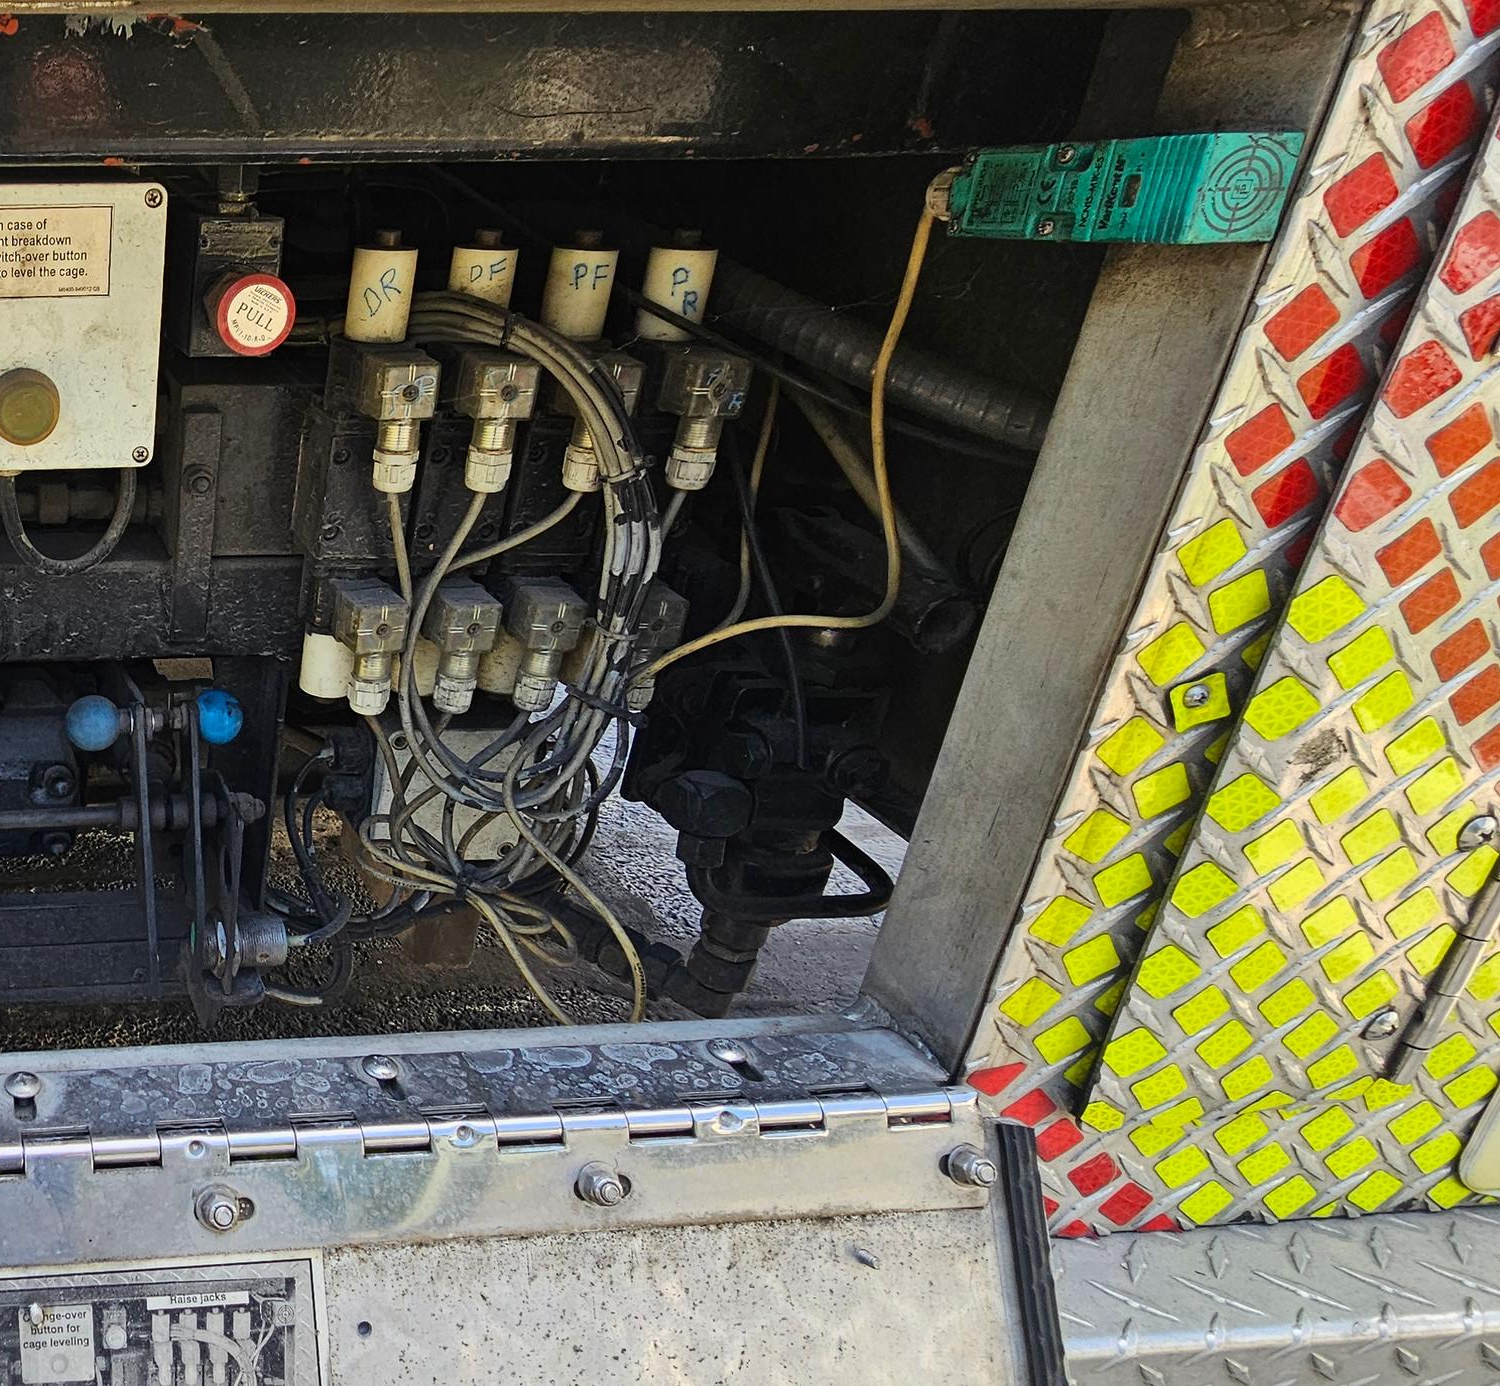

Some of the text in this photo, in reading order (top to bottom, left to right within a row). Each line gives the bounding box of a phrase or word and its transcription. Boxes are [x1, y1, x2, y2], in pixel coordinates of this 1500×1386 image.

[7, 220, 33, 231] case
[36, 218, 48, 230] of
[11, 234, 72, 247] breakdown
[52, 250, 88, 262] button
[11, 266, 36, 278] level
[39, 266, 56, 278] the
[59, 267, 89, 280] cage.
[470, 258, 507, 283] DF
[573, 263, 610, 290] PF
[364, 268, 402, 317] DR
[236, 302, 273, 332] PULL
[170, 1293, 227, 1305] Raise jacks
[22, 1310, 88, 1323] Cnge-over
[30, 1323, 80, 1336] button for
[23, 1336, 90, 1351] cage leveling
